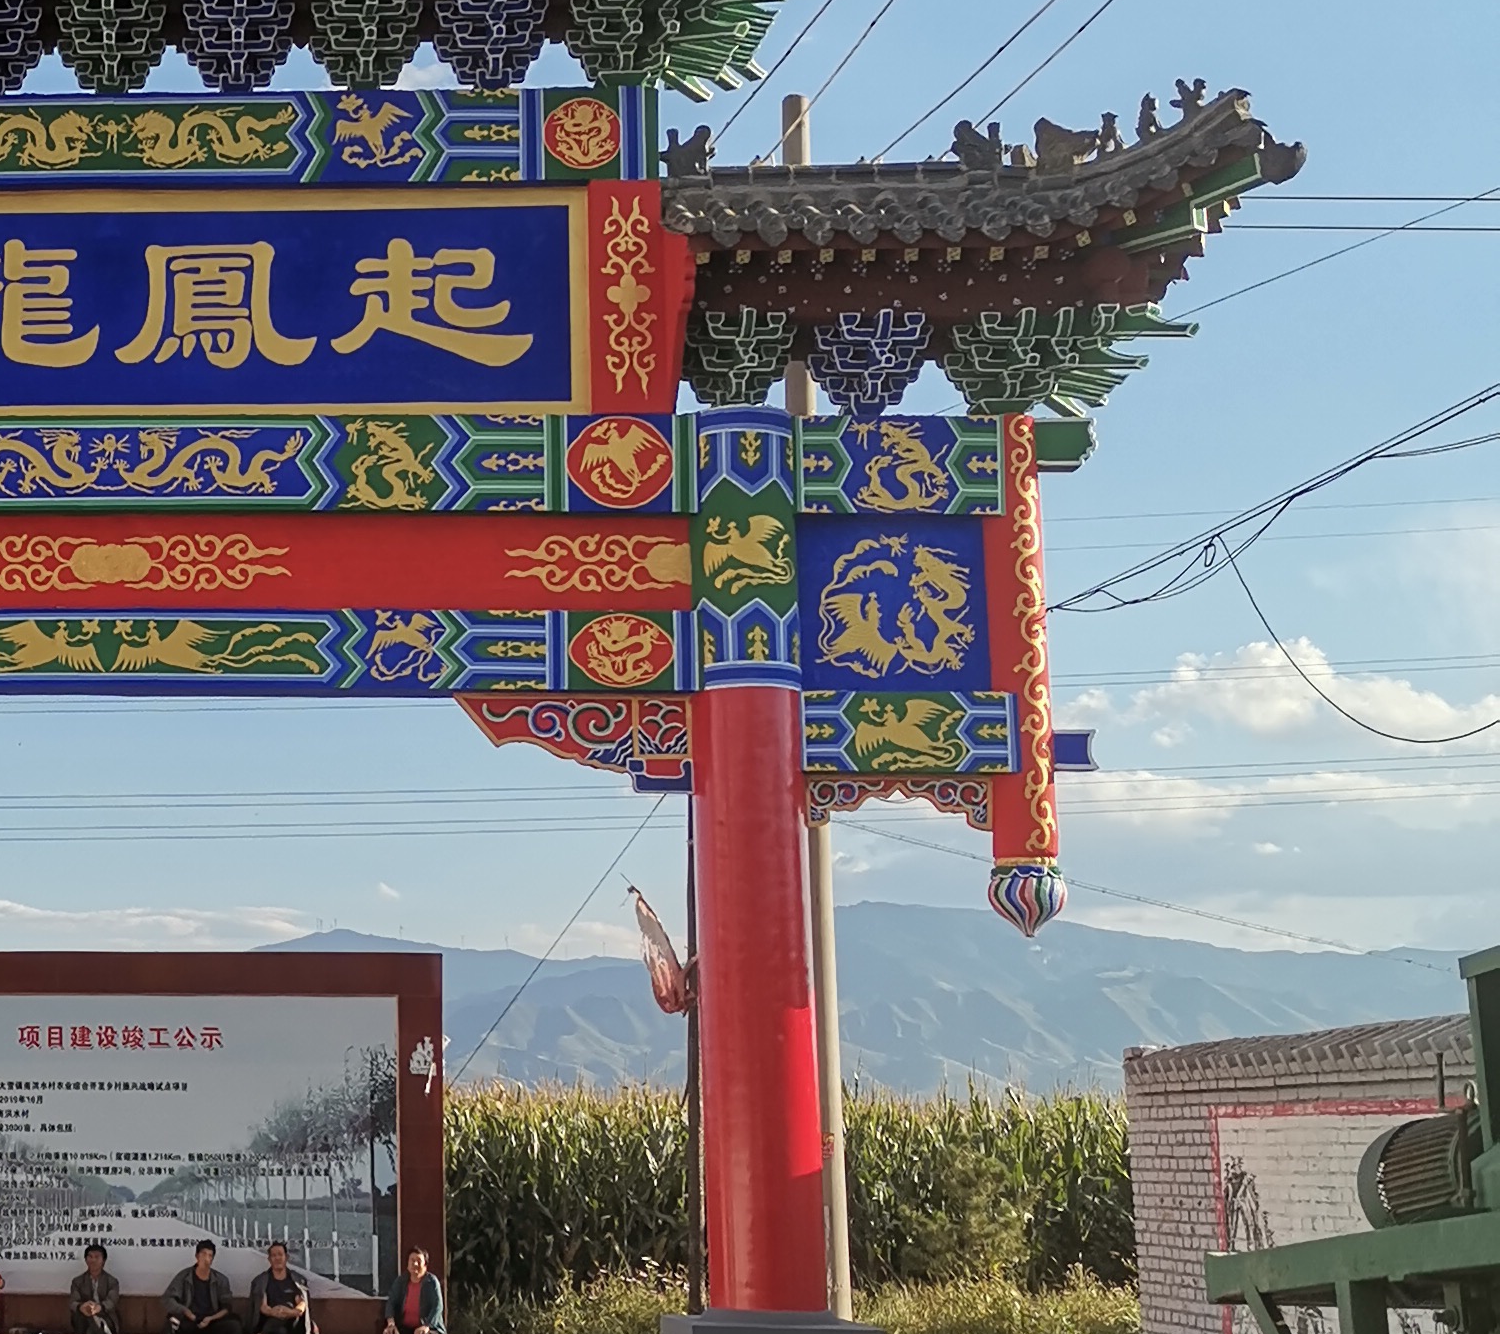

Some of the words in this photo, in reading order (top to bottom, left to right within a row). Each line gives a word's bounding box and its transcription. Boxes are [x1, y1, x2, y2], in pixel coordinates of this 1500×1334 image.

[17, 1025, 224, 1050] 项目建设竣工公示
